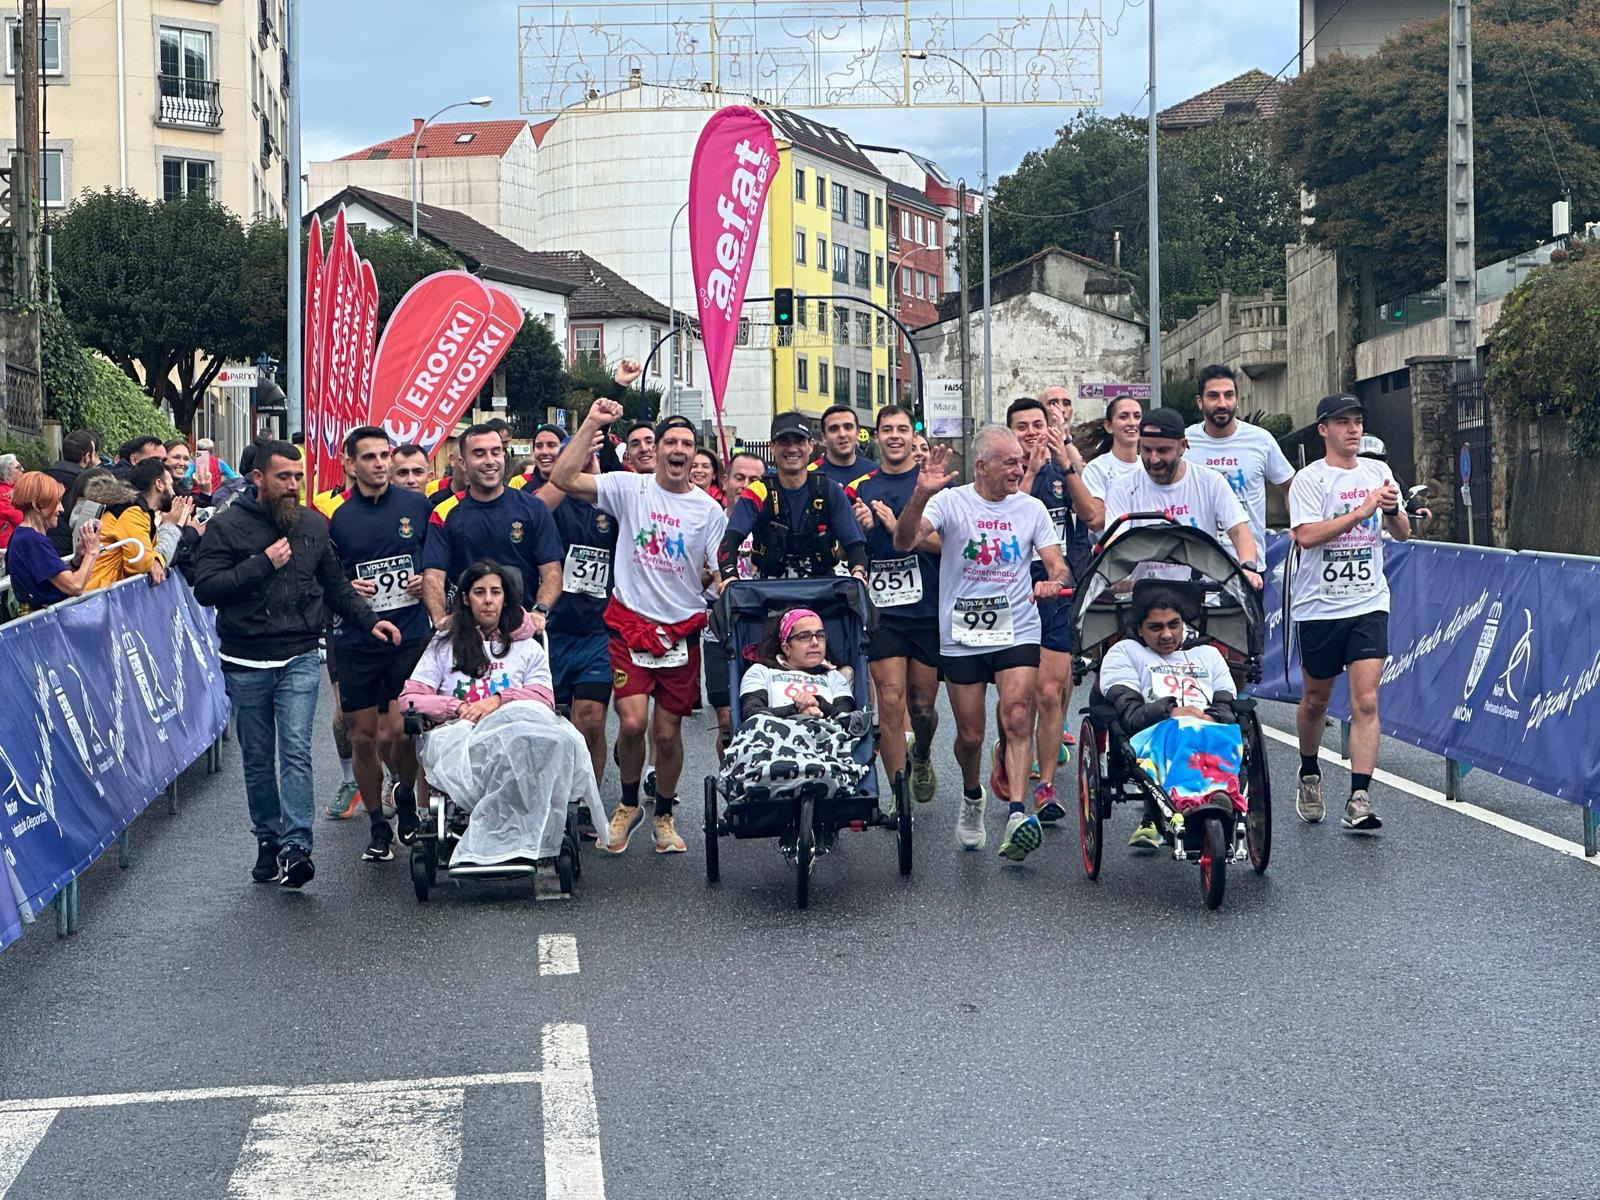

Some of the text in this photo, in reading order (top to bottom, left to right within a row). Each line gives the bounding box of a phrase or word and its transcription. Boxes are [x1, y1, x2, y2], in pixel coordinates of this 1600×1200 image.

[708, 139, 764, 310] aefat
[360, 303, 376, 403] EROSKI
[405, 311, 476, 408] EROSKI
[438, 324, 506, 415] EROSKI
[933, 402, 957, 411] Mara
[1206, 456, 1238, 466] aefat
[650, 512, 681, 528] aefat
[977, 519, 1013, 532] aefat
[366, 562, 389, 571] VOLTA
[572, 559, 607, 583] 311
[1323, 560, 1371, 582] 645
[872, 569, 914, 591] 651
[963, 611, 998, 631] 99
[1163, 674, 1198, 697] 92
